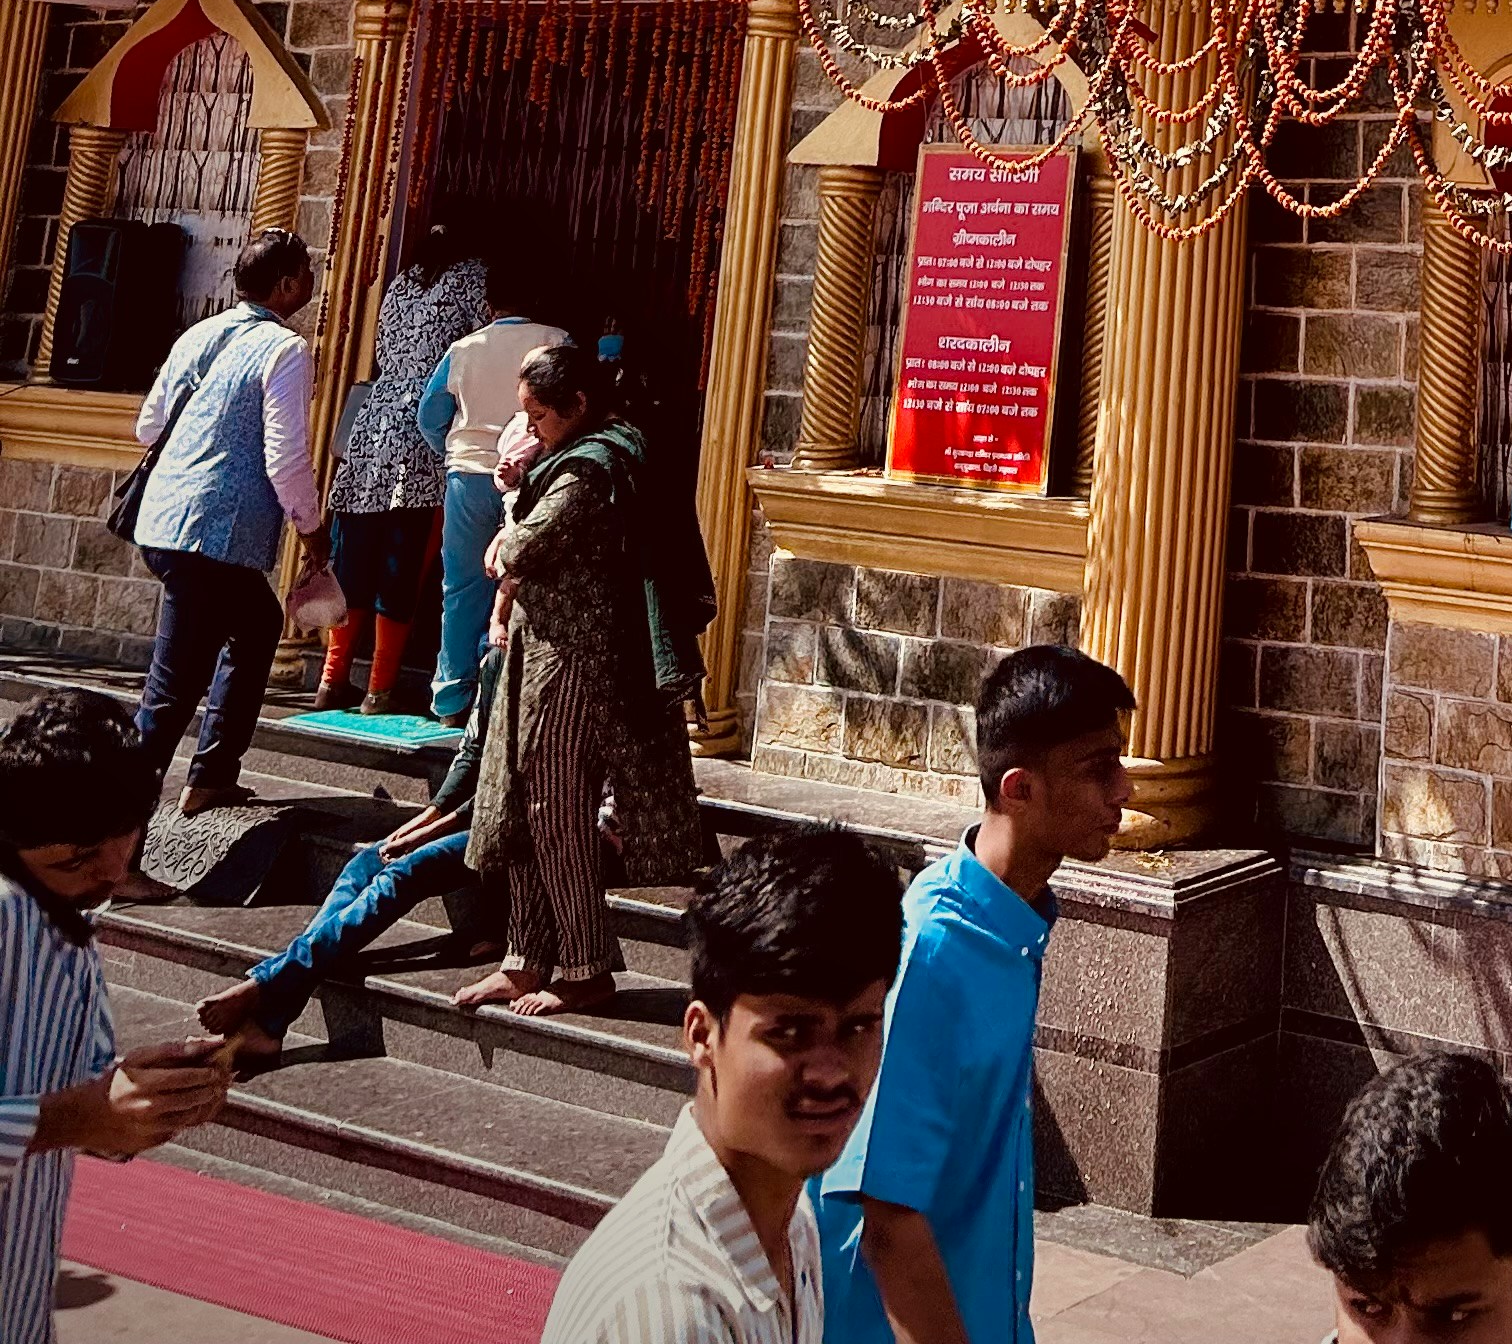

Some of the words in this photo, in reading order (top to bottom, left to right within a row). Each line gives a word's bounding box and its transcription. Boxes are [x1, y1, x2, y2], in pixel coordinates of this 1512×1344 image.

[949, 167, 986, 182] समय
[956, 201, 978, 221] पूजा
[980, 198, 1012, 215] अर्चना
[1014, 203, 1029, 215] का
[1031, 203, 1060, 216] समय
[952, 228, 1017, 248] ग्रीष्मकालीन
[976, 255, 985, 269] से
[936, 293, 953, 307] बजे
[955, 294, 963, 307] से
[1011, 297, 1029, 311] बजे
[938, 334, 1011, 353] शरदकालीन
[967, 358, 976, 372] से
[926, 397, 943, 411] बजे
[945, 398, 954, 412] से
[1001, 403, 1019, 417] बजे
